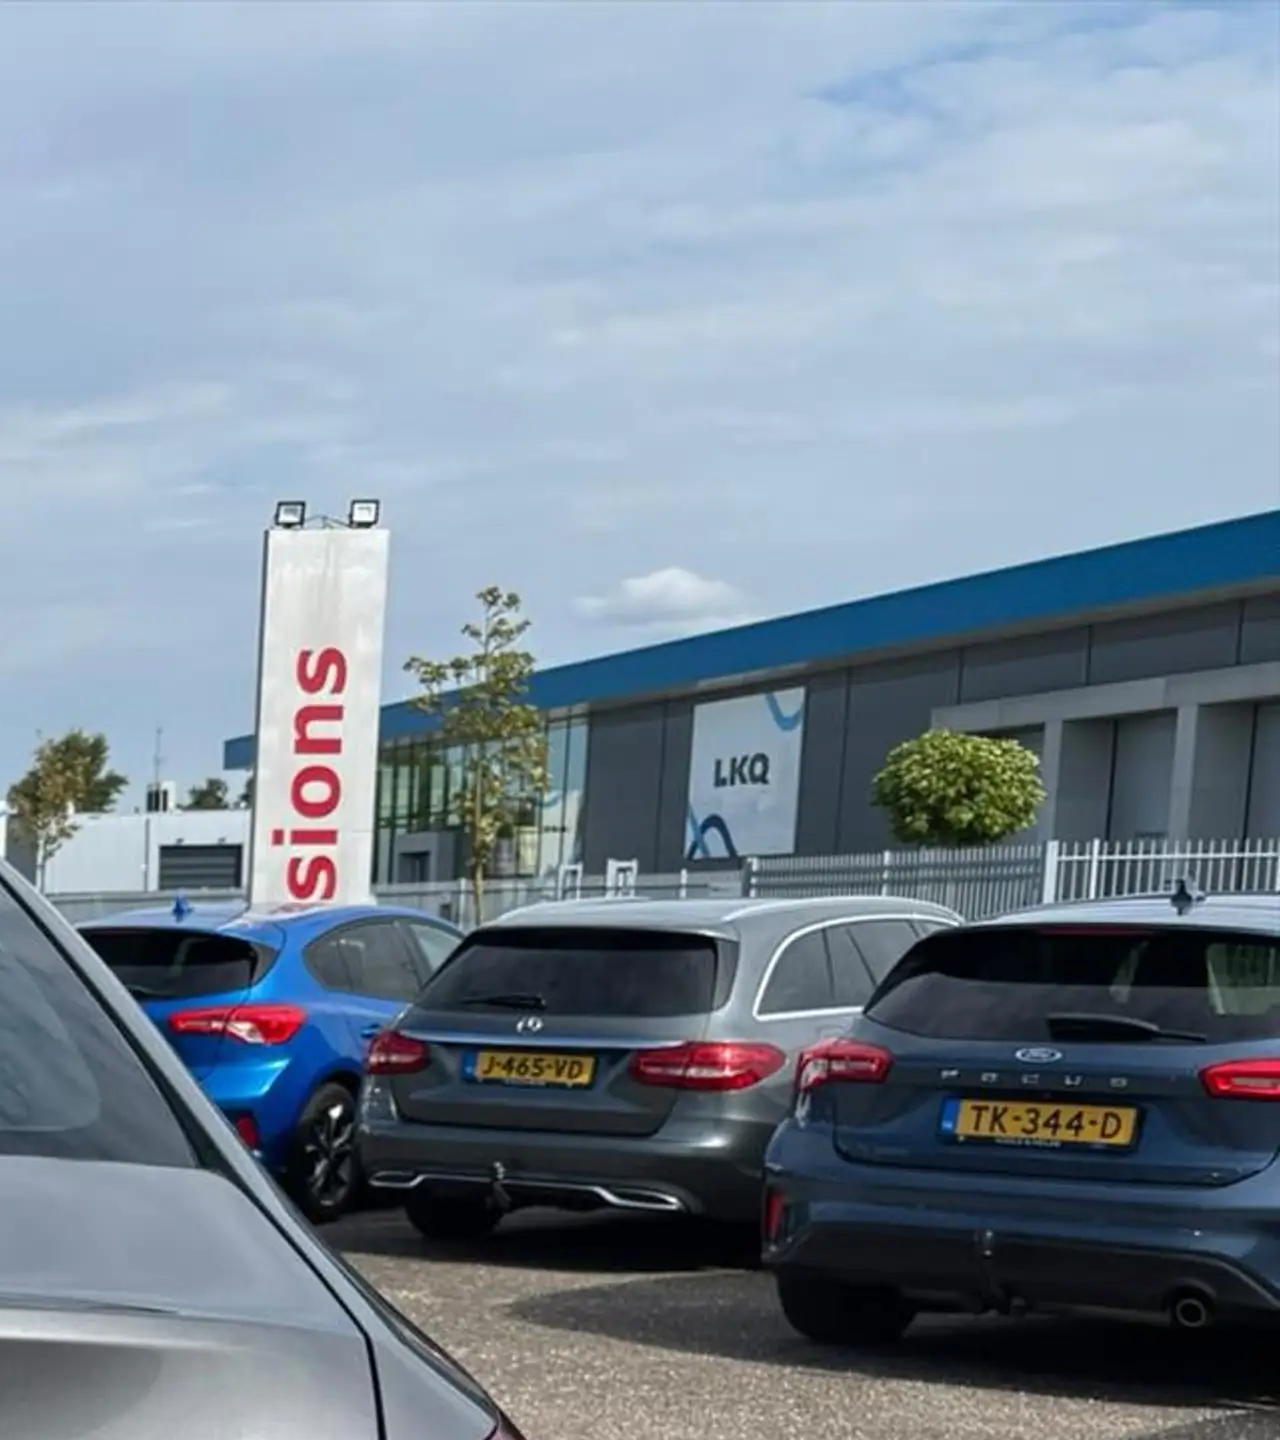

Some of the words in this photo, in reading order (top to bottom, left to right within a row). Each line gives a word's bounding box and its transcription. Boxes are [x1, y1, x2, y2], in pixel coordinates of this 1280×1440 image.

[272, 647, 348, 901] sions
[713, 751, 770, 789] LKQ
[481, 1055, 584, 1080] J-465-VD
[969, 1105, 1122, 1140] TK-344-D
